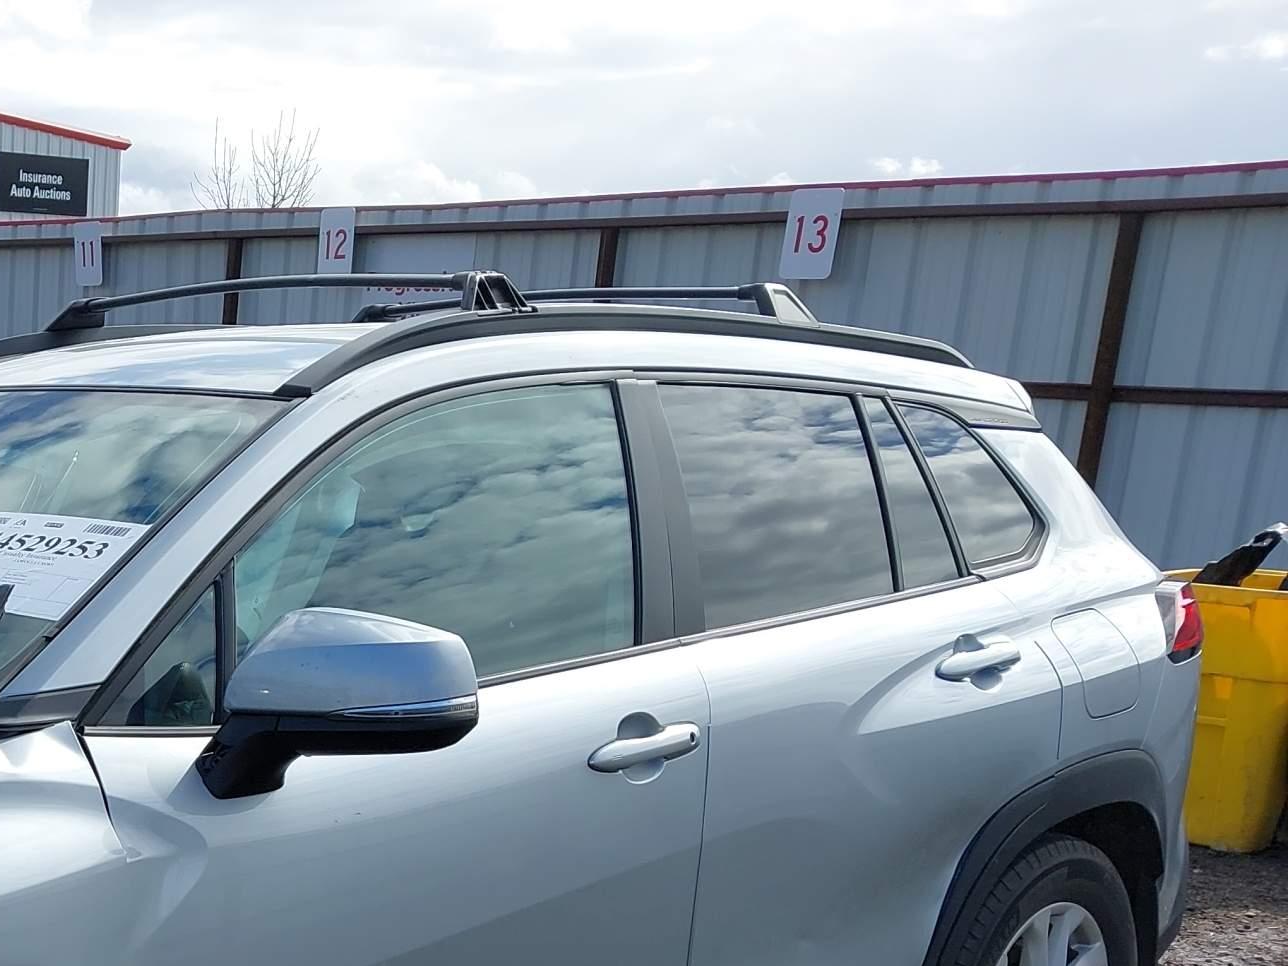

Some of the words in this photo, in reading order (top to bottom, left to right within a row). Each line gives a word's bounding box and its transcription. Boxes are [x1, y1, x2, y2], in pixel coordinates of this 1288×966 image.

[19, 169, 63, 185] Insurance
[10, 184, 32, 198] Auto
[33, 186, 71, 201] Auctions
[325, 229, 348, 260] 12
[793, 214, 829, 254] 13
[80, 240, 95, 268] 11
